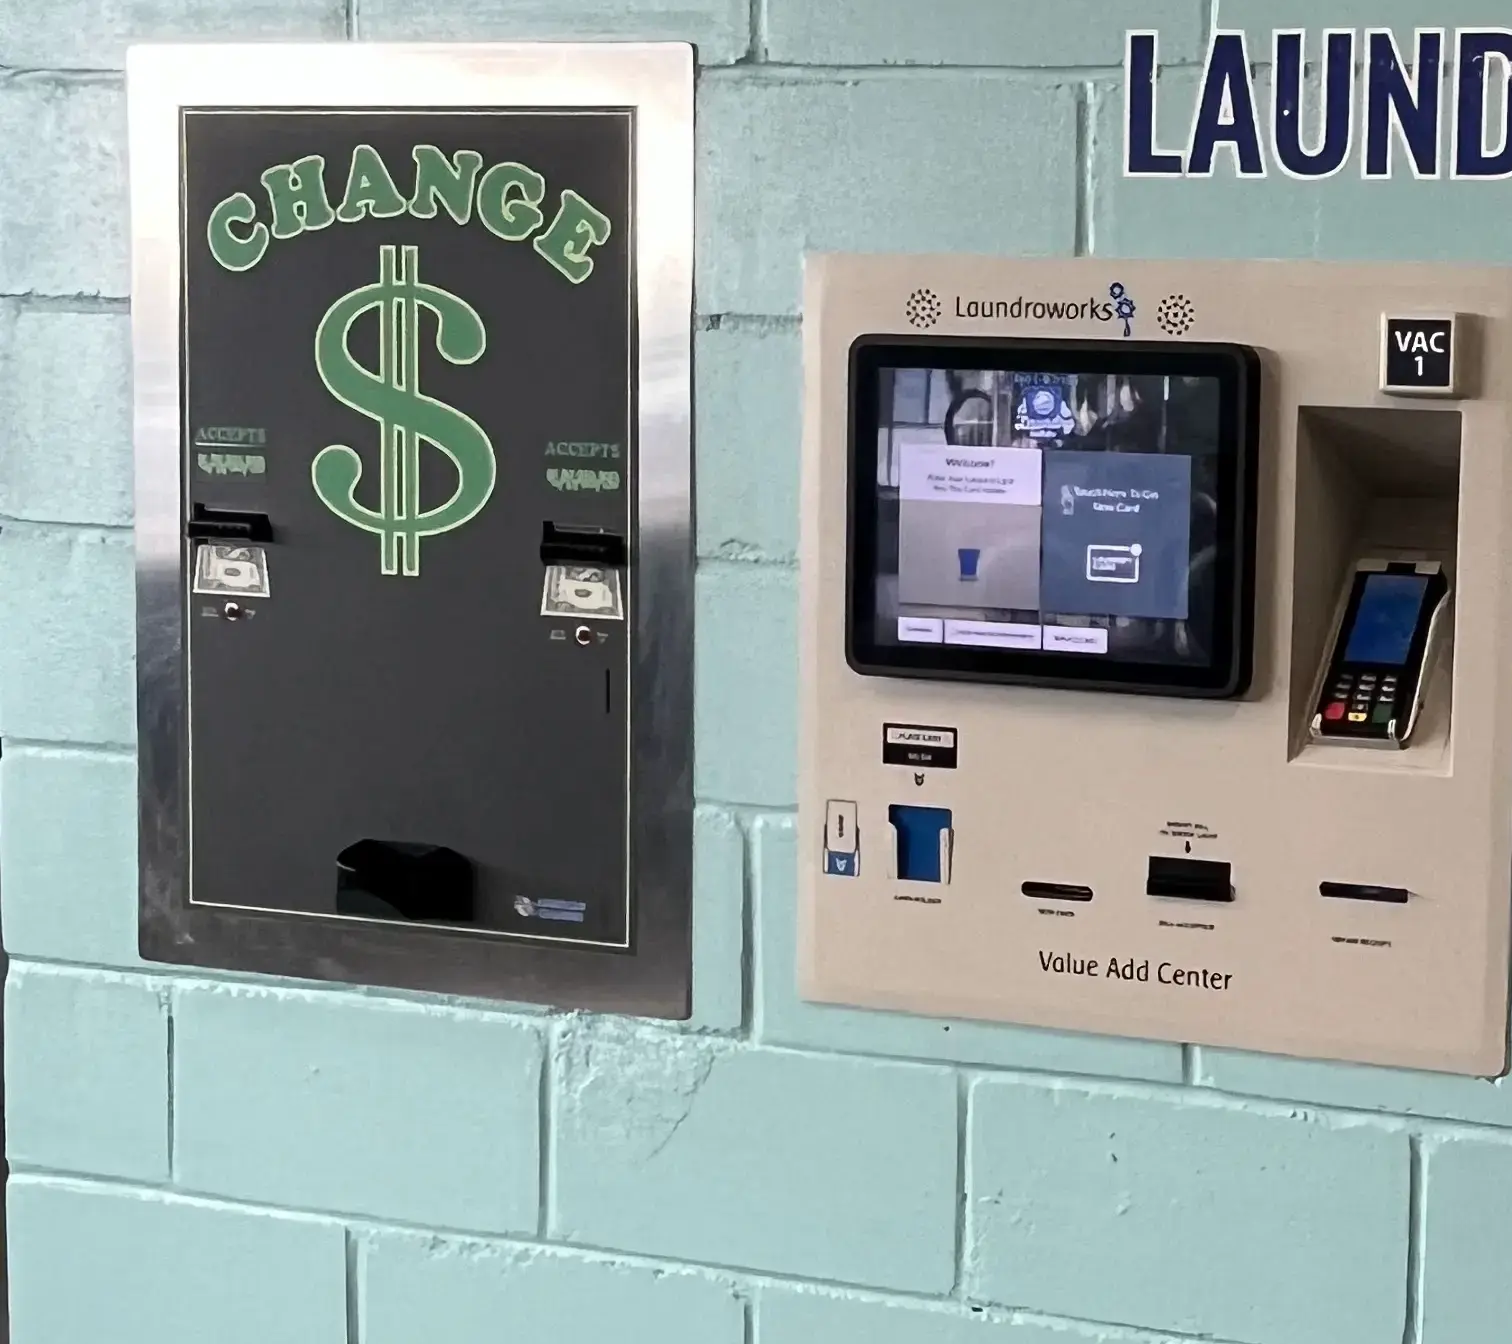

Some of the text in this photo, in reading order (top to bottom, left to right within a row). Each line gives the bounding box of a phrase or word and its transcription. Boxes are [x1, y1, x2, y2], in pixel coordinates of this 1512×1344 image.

[207, 144, 611, 284] CHANGE
[956, 295, 1114, 322] Laundroworks
[1394, 330, 1446, 354] VAC
[1414, 355, 1424, 377] 1
[545, 441, 621, 459] ACCEPTS
[1039, 950, 1234, 990] Value Add Center
